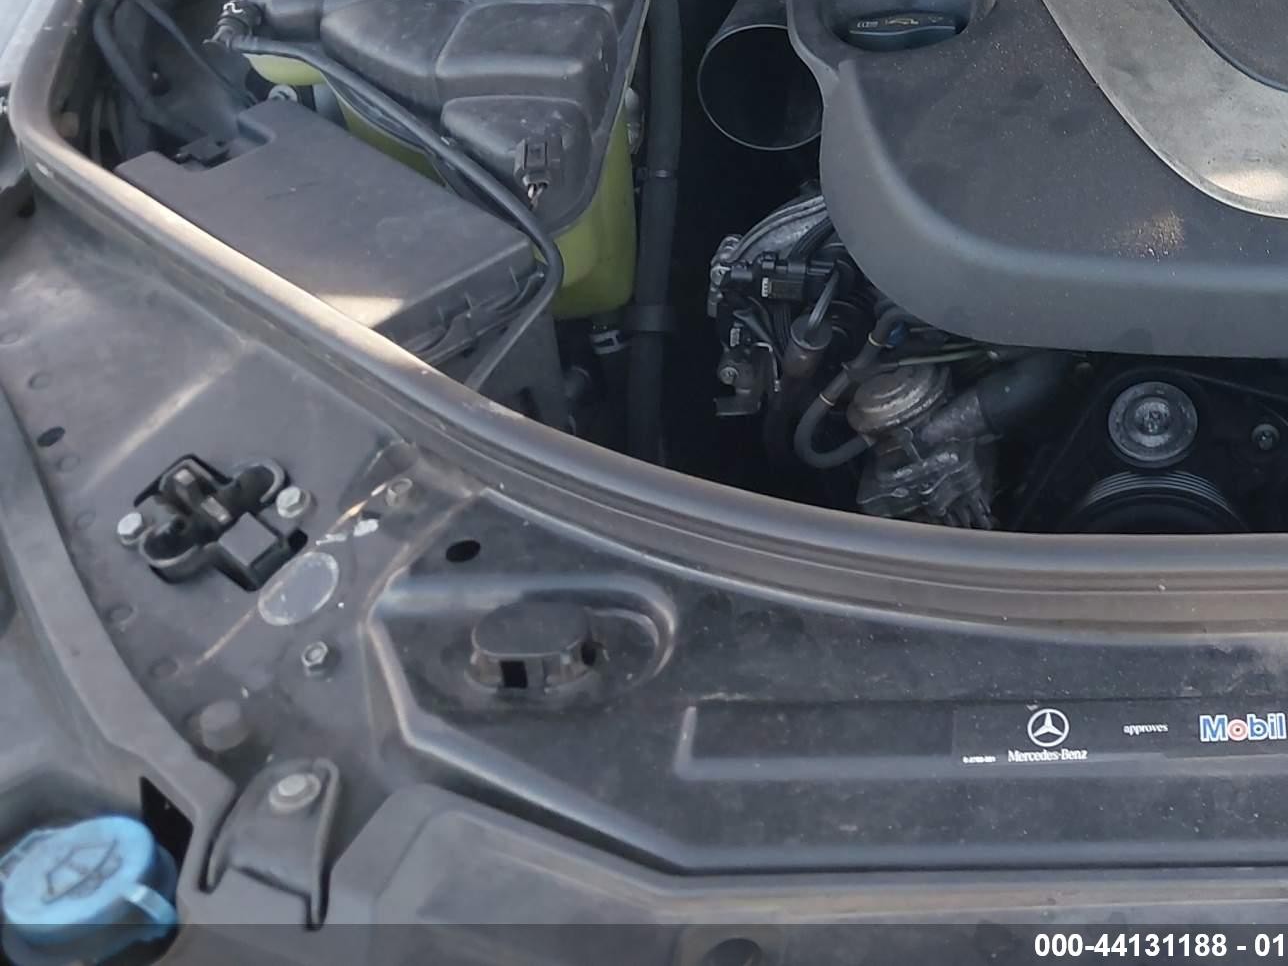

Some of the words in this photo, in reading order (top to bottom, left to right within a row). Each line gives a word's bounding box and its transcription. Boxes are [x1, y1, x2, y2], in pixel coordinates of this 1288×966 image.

[1123, 723, 1169, 736] approves
[1200, 712, 1287, 742] Mobil
[1007, 748, 1088, 762] Mercedes-Benz
